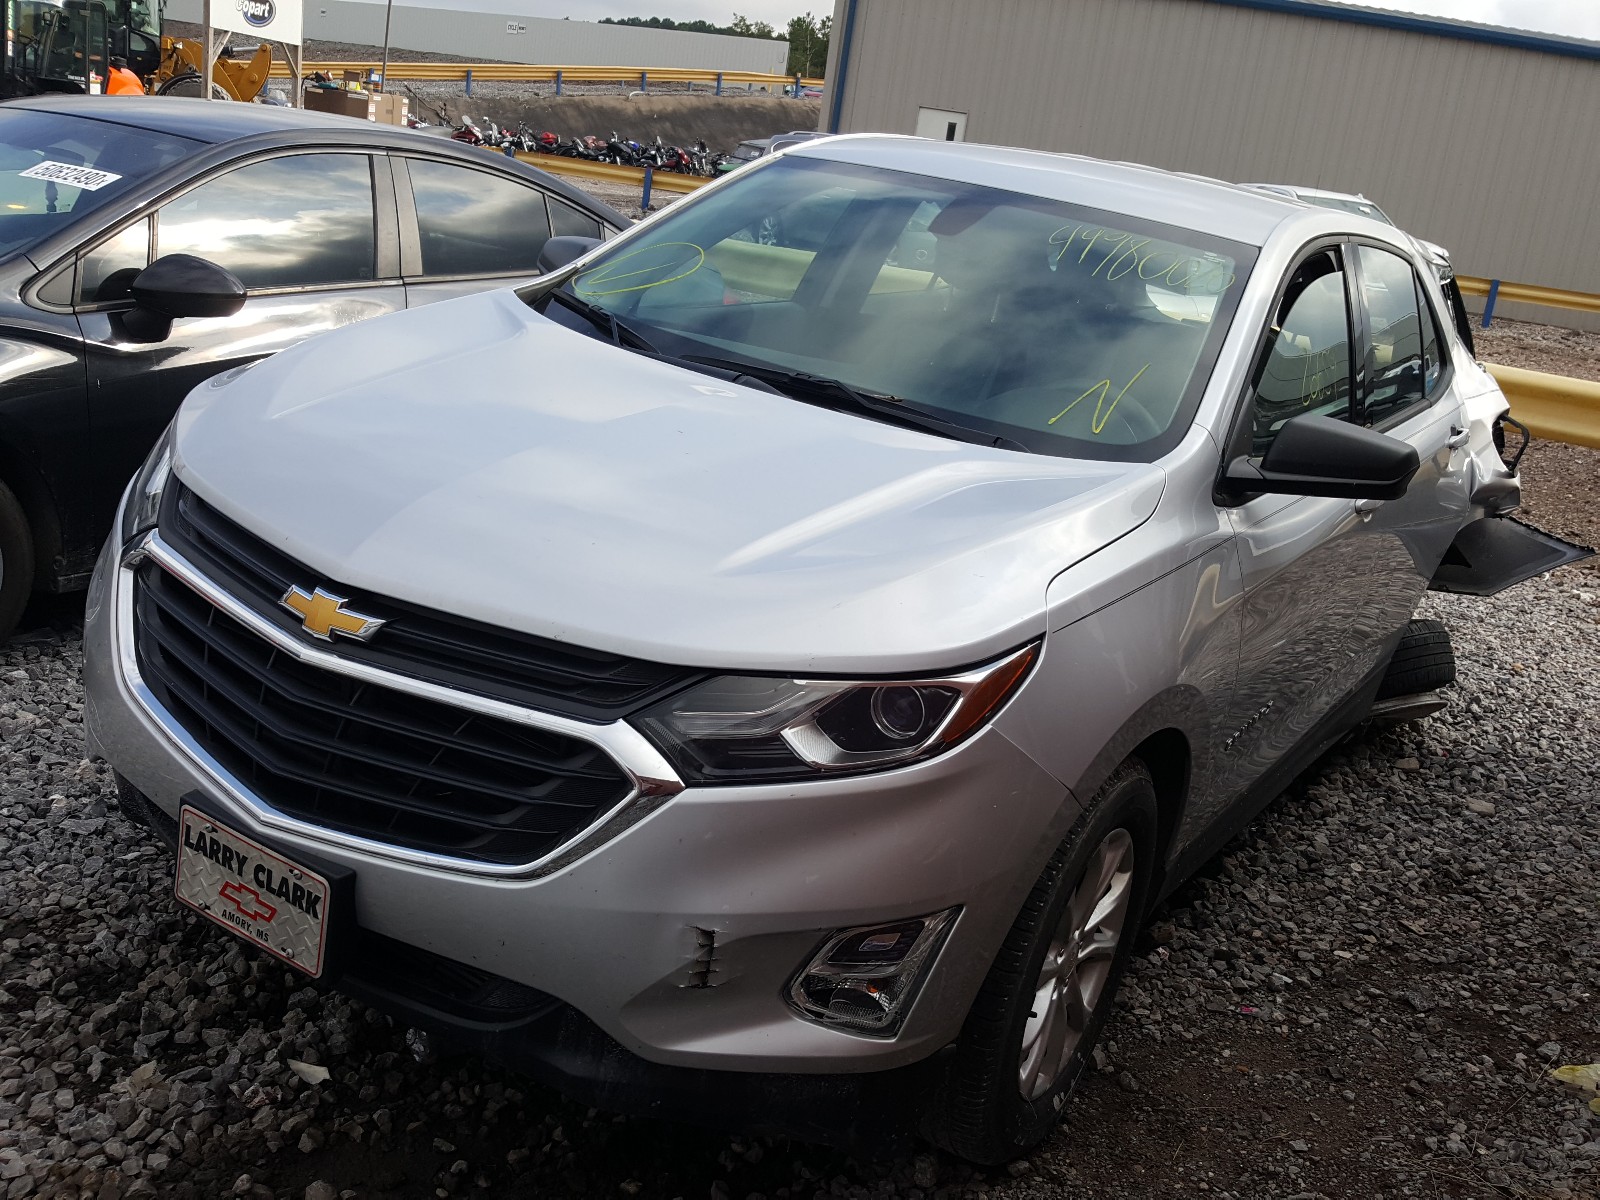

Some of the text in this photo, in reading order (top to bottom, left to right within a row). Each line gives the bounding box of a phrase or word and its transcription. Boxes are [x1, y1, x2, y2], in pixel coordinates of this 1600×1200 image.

[235, 0, 270, 18] Copart
[1047, 362, 1151, 434] N
[183, 824, 322, 919] LARRY CLARK
[221, 909, 269, 942] AMORY, MS
